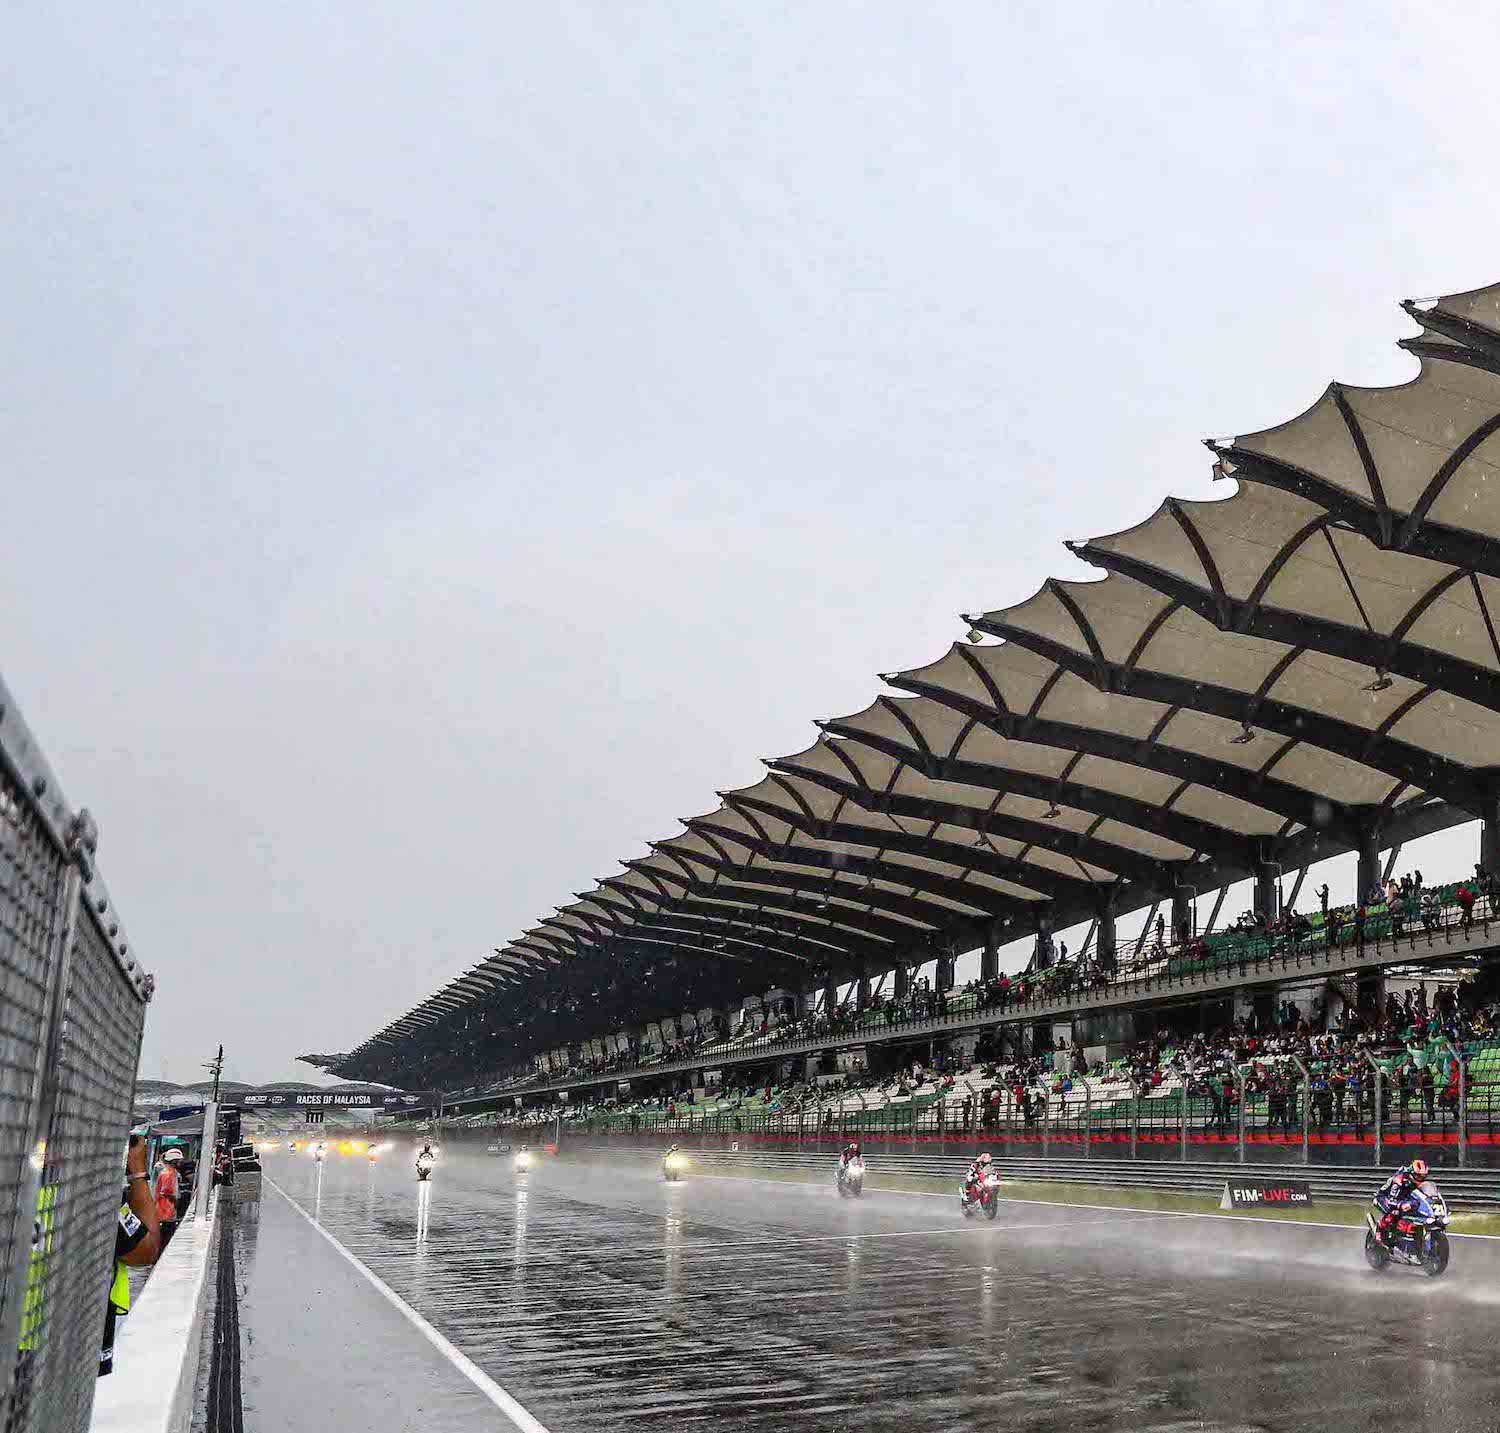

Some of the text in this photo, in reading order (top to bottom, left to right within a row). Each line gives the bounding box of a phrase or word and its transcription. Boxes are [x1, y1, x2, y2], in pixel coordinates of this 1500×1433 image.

[296, 1095, 321, 1105] RACES
[323, 1095, 334, 1105] OF
[334, 1095, 372, 1105] MALAYSIA
